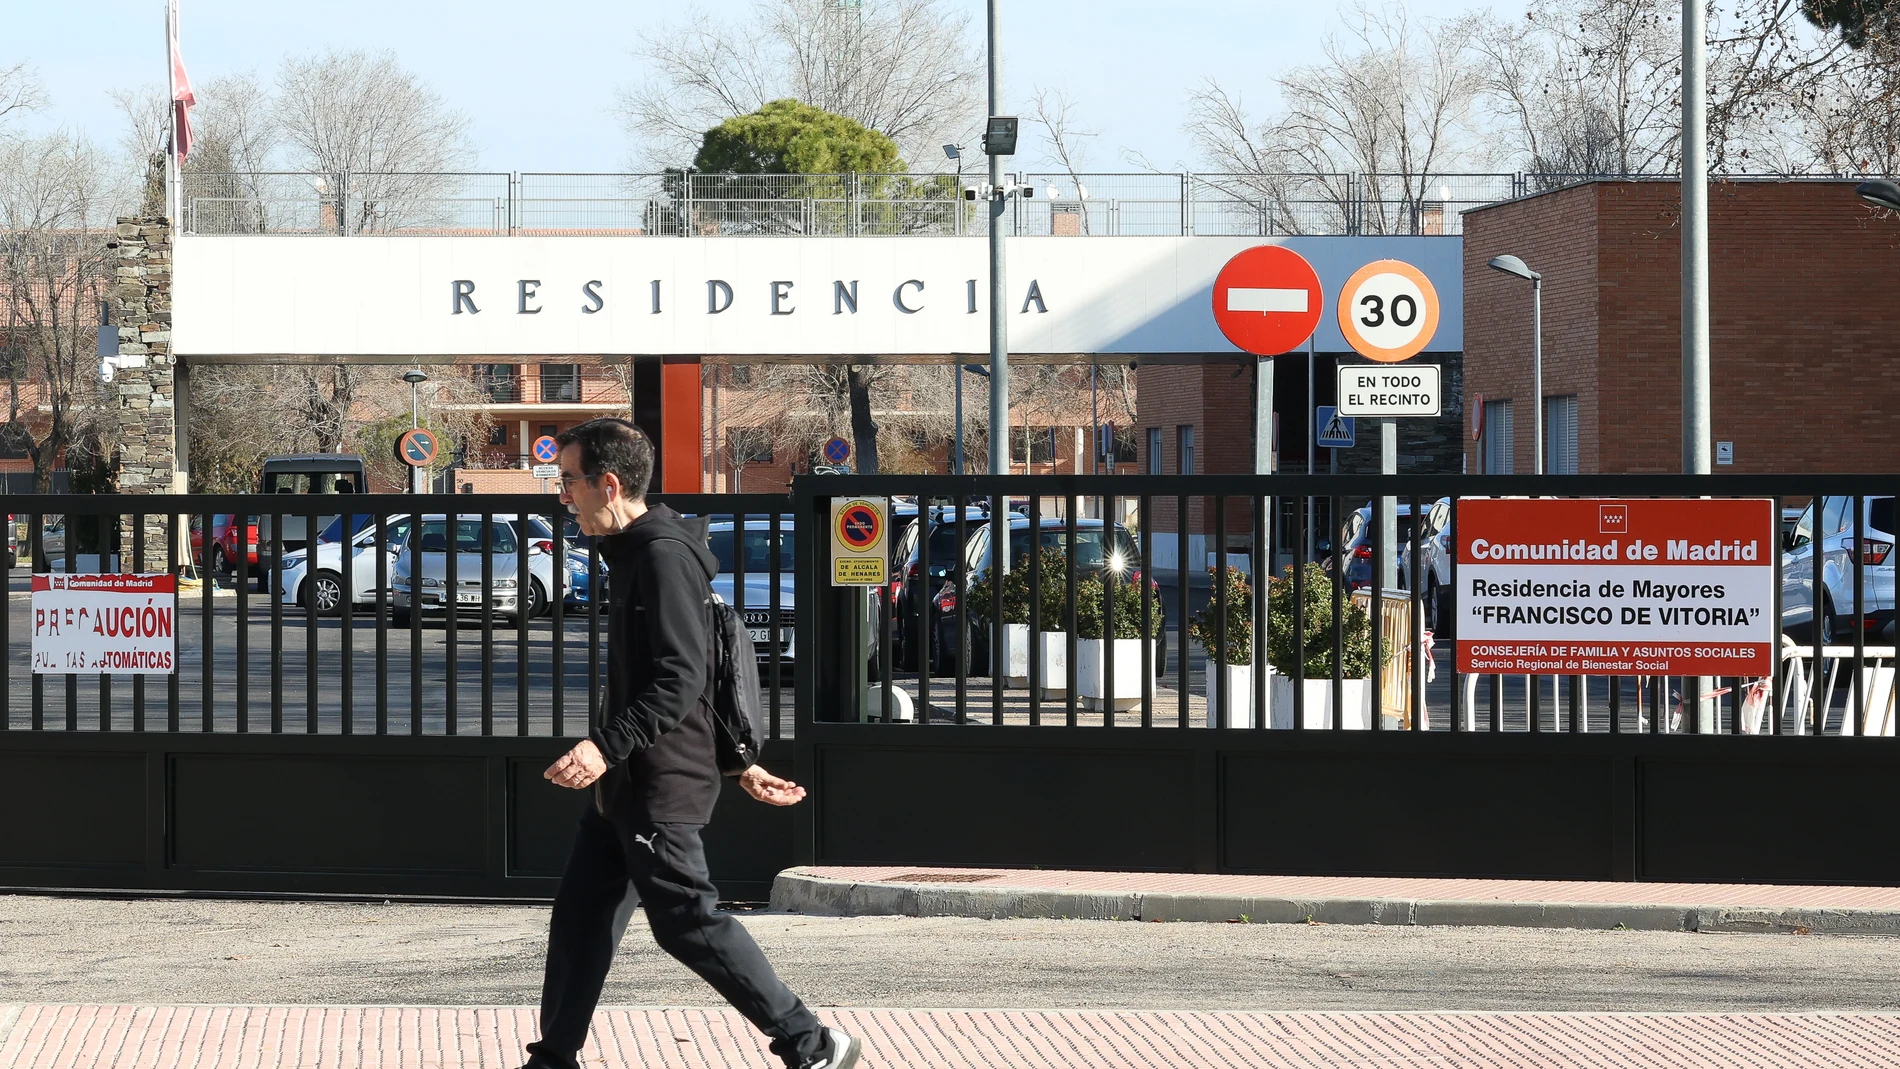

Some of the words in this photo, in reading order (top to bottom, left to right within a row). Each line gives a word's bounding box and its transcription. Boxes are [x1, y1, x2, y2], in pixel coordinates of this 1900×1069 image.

[451, 279, 1049, 315] RESIDENCIA
[1360, 294, 1417, 327] 30
[1358, 376, 1376, 388] EN
[1382, 376, 1421, 388] TODO
[1348, 394, 1364, 405] EL
[1370, 394, 1430, 405] RECINTO
[1470, 538, 1618, 560] Comunidad
[1625, 539, 1658, 561] de
[1666, 540, 1758, 561] Madrid
[69, 579, 112, 587] Comunidad
[114, 579, 124, 587] de
[126, 579, 153, 587] Madrid
[1472, 579, 1591, 598] Residencia
[1598, 580, 1625, 598] de
[1632, 580, 1725, 602] Mayores
[1621, 607, 1650, 625] DE
[1470, 644, 1547, 657] CONSEJERÍA
[1550, 646, 1567, 656] DE
[1570, 646, 1619, 657] FAMILIA
[1621, 647, 1630, 657] Y
[1632, 647, 1691, 658] ASUNTOS
[1694, 647, 1755, 658] SOCIALES
[1470, 659, 1513, 669] Servicio
[1516, 659, 1563, 672] Regional
[1566, 660, 1579, 669] de
[1582, 660, 1633, 670] Bienestar
[1635, 660, 1669, 670] Social
